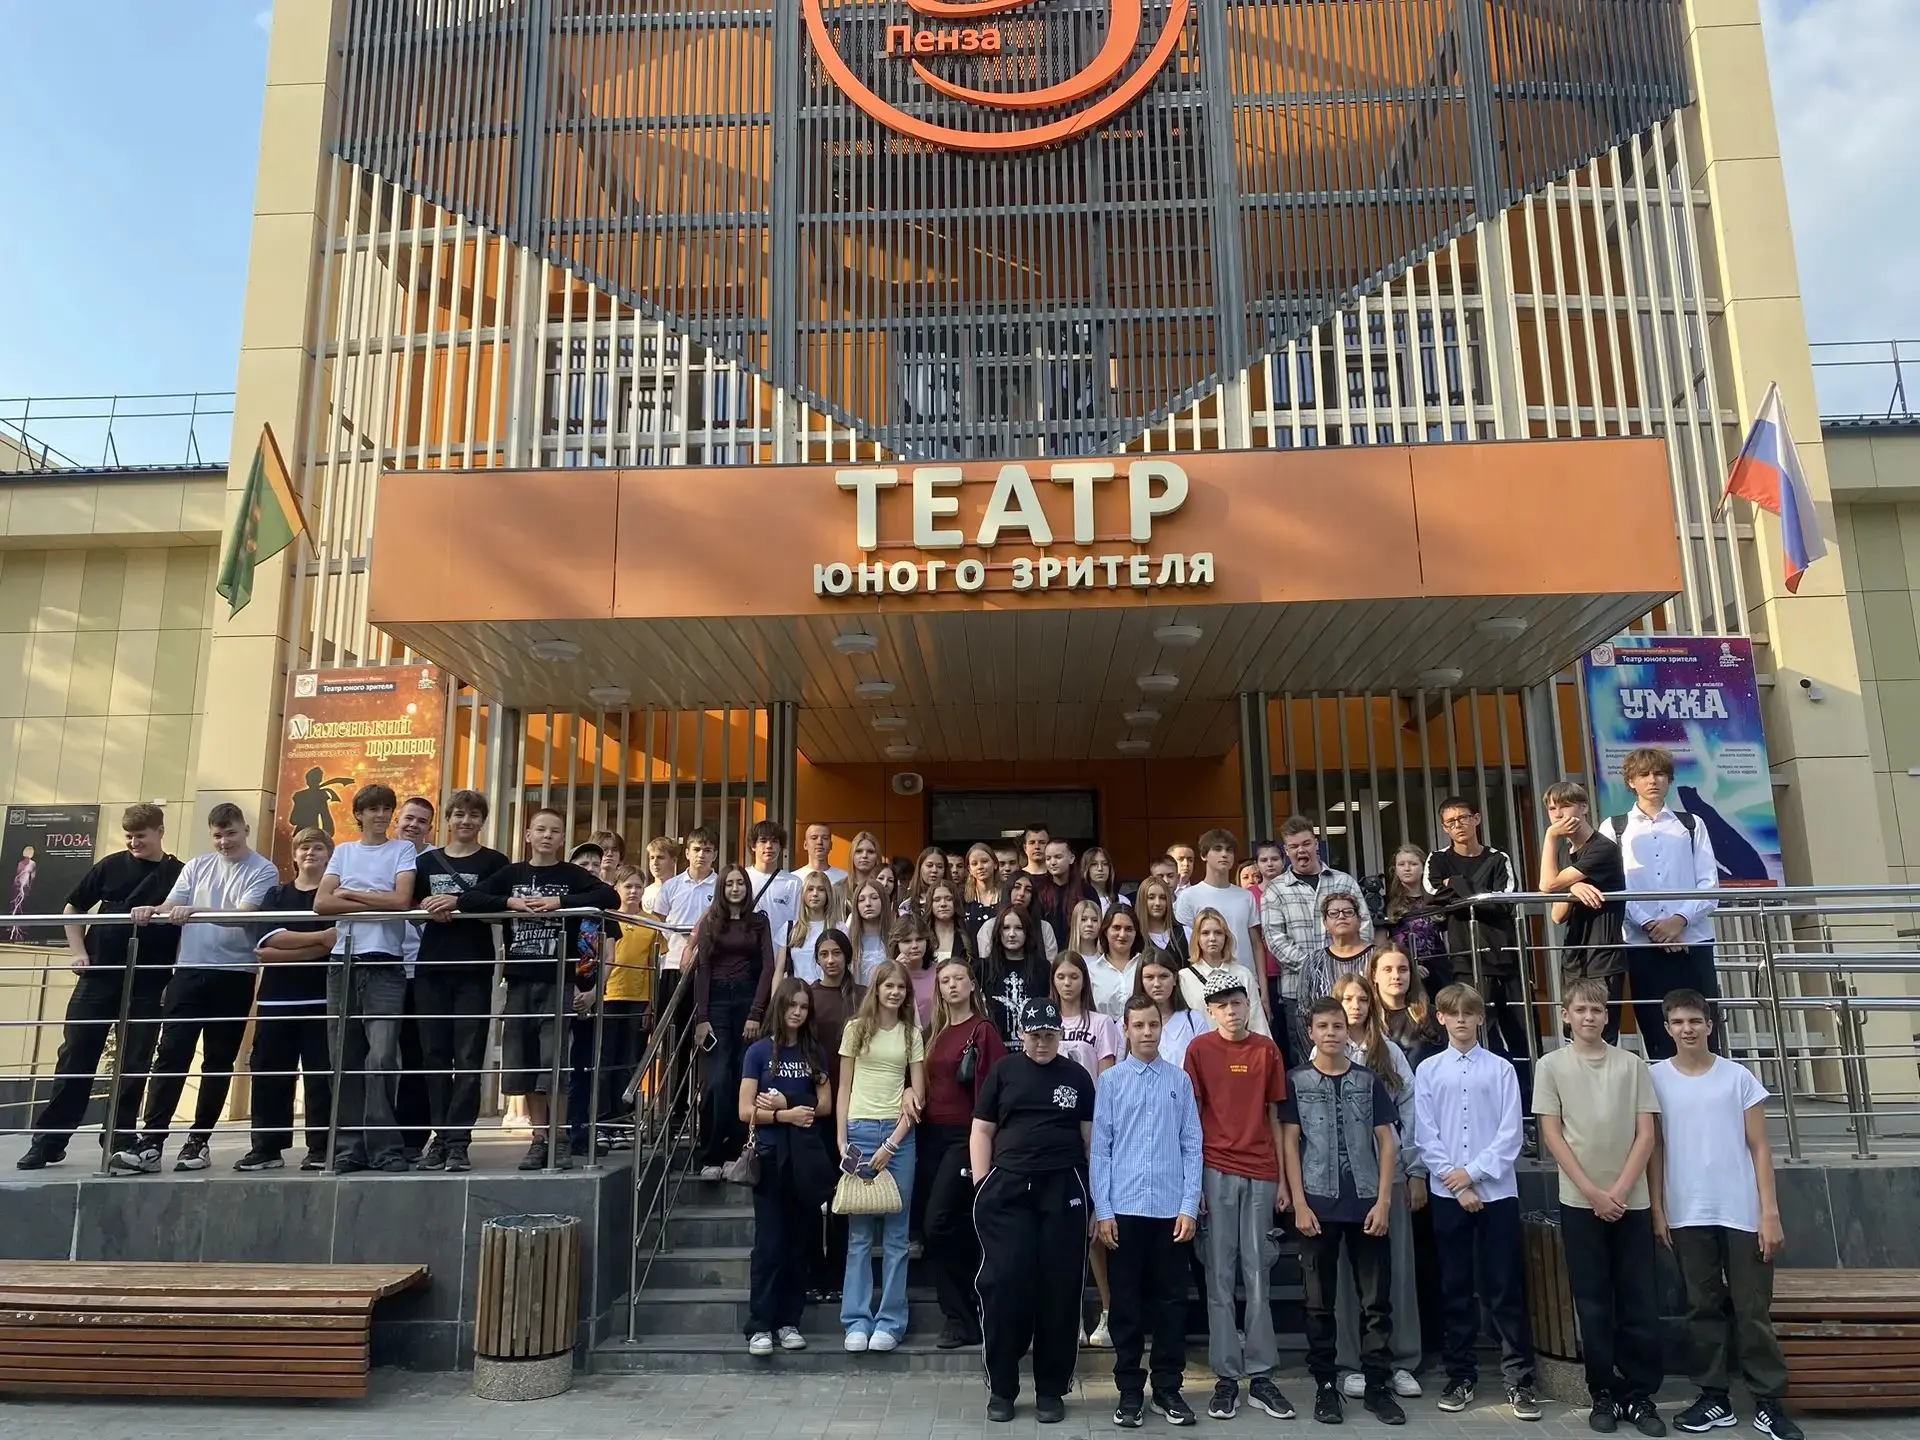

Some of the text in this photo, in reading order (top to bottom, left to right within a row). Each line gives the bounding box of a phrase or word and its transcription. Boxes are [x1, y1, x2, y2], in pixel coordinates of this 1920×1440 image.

[887, 25, 1001, 54] Пенза
[835, 460, 1189, 551] ТЕАТР
[814, 552, 1215, 595] ЮНОГО ЗРИТЕЛЯ
[1622, 655, 1643, 663] Театр
[1668, 656, 1698, 664] зрителя
[1620, 689, 1729, 719] УМКА
[288, 714, 412, 740] Маленький
[365, 738, 436, 761] принц
[46, 833, 93, 847] ГРОЗА
